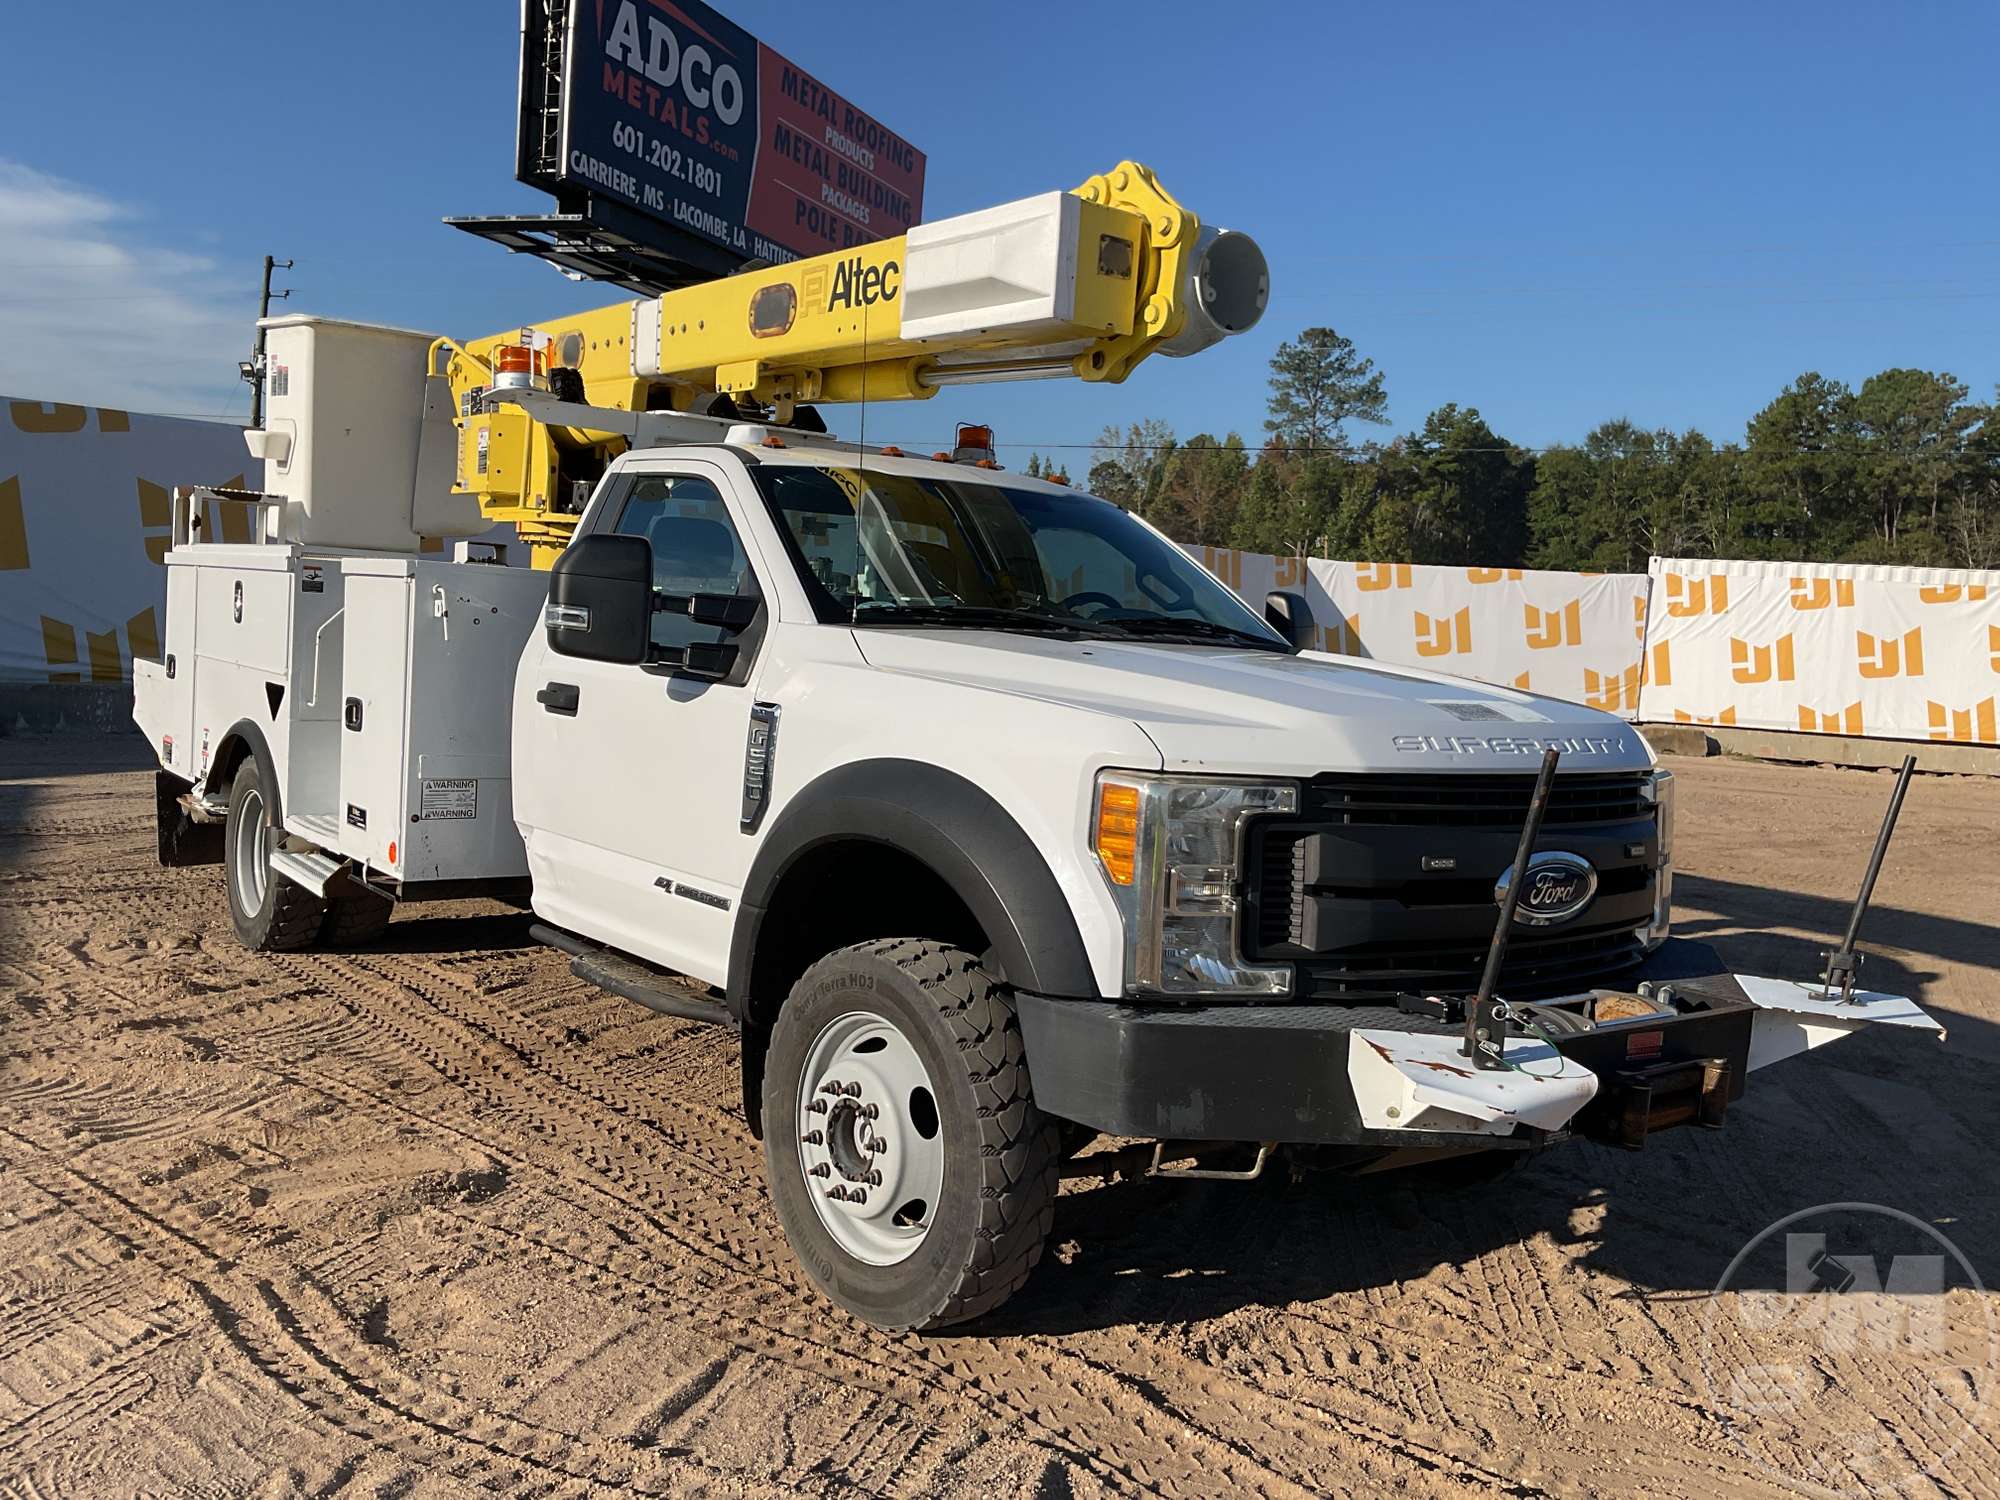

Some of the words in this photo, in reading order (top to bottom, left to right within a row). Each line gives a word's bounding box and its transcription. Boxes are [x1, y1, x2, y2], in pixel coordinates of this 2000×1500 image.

[605, 0, 743, 126] ADCO
[781, 66, 838, 127] METAL
[843, 106, 914, 173] ROOFING
[612, 120, 722, 198] 601.202.1801
[825, 126, 875, 171] PRODUCTS
[570, 149, 640, 204] CARRIERE,
[643, 183, 664, 212] MS
[673, 198, 731, 246] LACOMBE,
[733, 225, 747, 250] LA
[774, 124, 831, 181] METAL
[837, 162, 913, 226] BUILDING
[796, 199, 838, 244] POLE
[821, 183, 870, 226] PACKAGES
[828, 257, 899, 313] Altec
[433, 780, 475, 789] WARNING
[432, 809, 473, 818] WARNING
[1530, 871, 1577, 905] Ford
